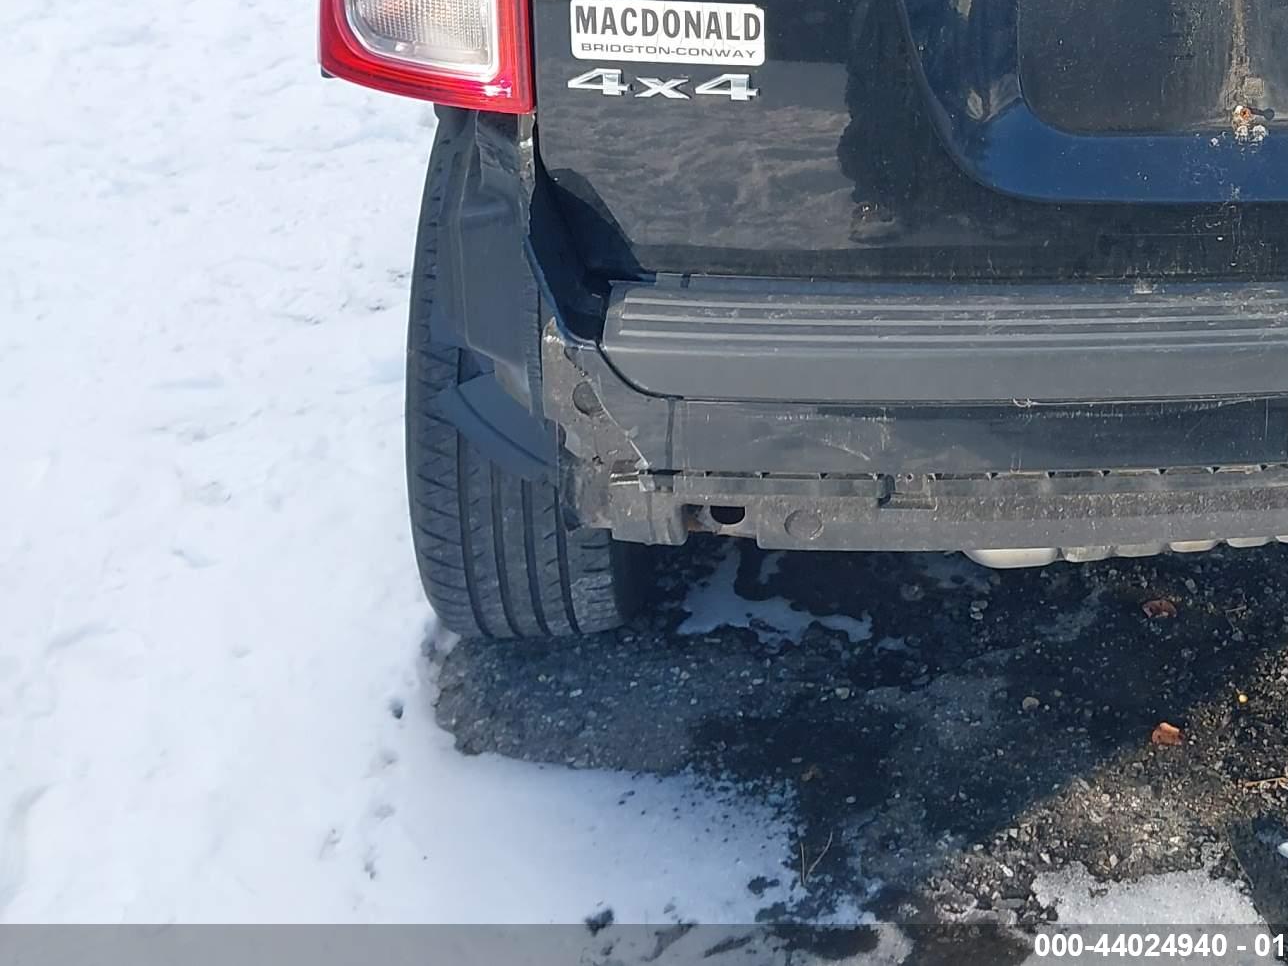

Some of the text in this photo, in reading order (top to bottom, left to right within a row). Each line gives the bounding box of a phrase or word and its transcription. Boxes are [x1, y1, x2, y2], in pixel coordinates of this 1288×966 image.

[575, 5, 761, 41] MACDONALD
[581, 42, 756, 59] BRIDGTON-CONWAY
[567, 67, 761, 101] 4x4
